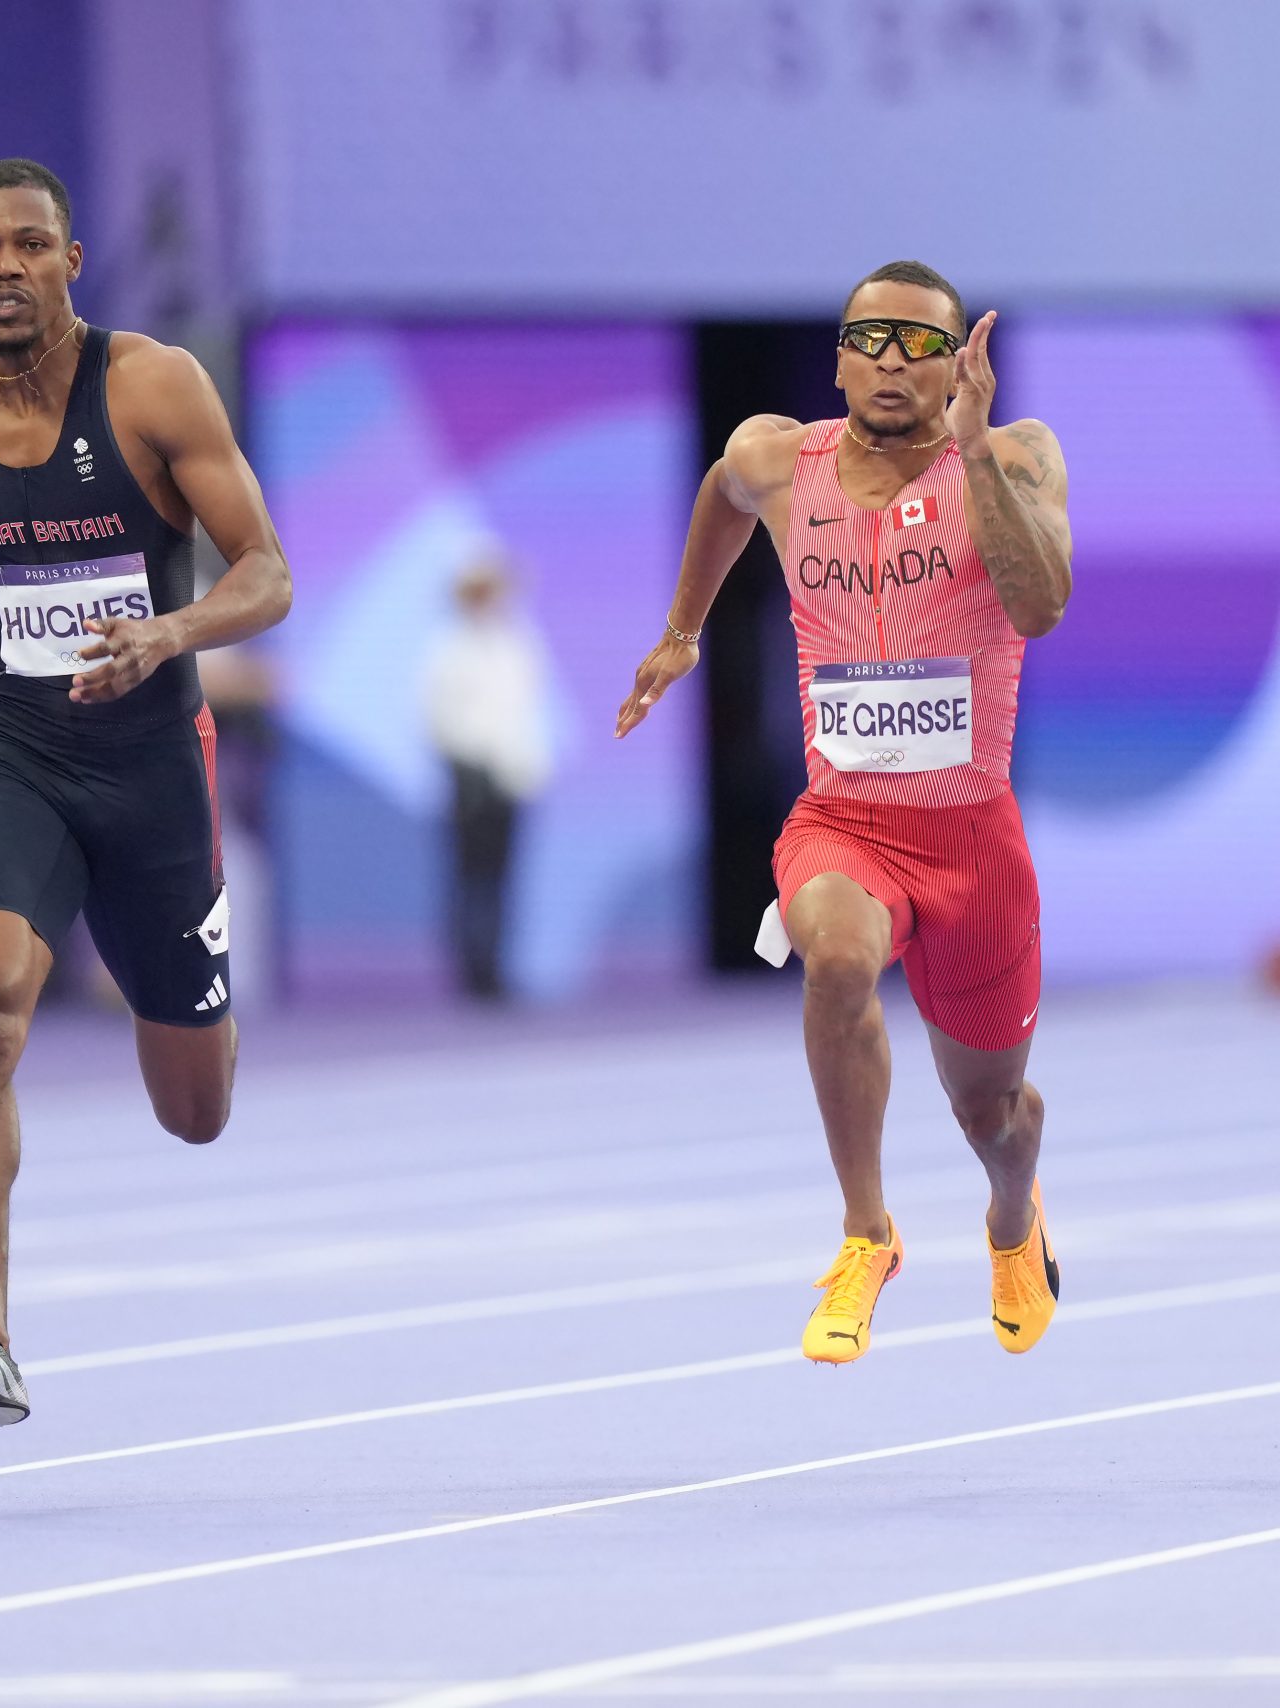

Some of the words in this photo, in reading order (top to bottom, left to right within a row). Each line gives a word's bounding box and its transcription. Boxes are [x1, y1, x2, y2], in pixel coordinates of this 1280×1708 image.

[31, 512, 125, 543] BRITAIN
[25, 569, 60, 580] PARIS
[64, 565, 100, 577] 2024
[799, 546, 954, 595] CANADA
[3, 593, 149, 640] HUGHES
[846, 665, 883, 677] PARIS
[888, 664, 925, 675] 2024
[820, 701, 848, 736] DE
[853, 697, 967, 737] GRASSE
